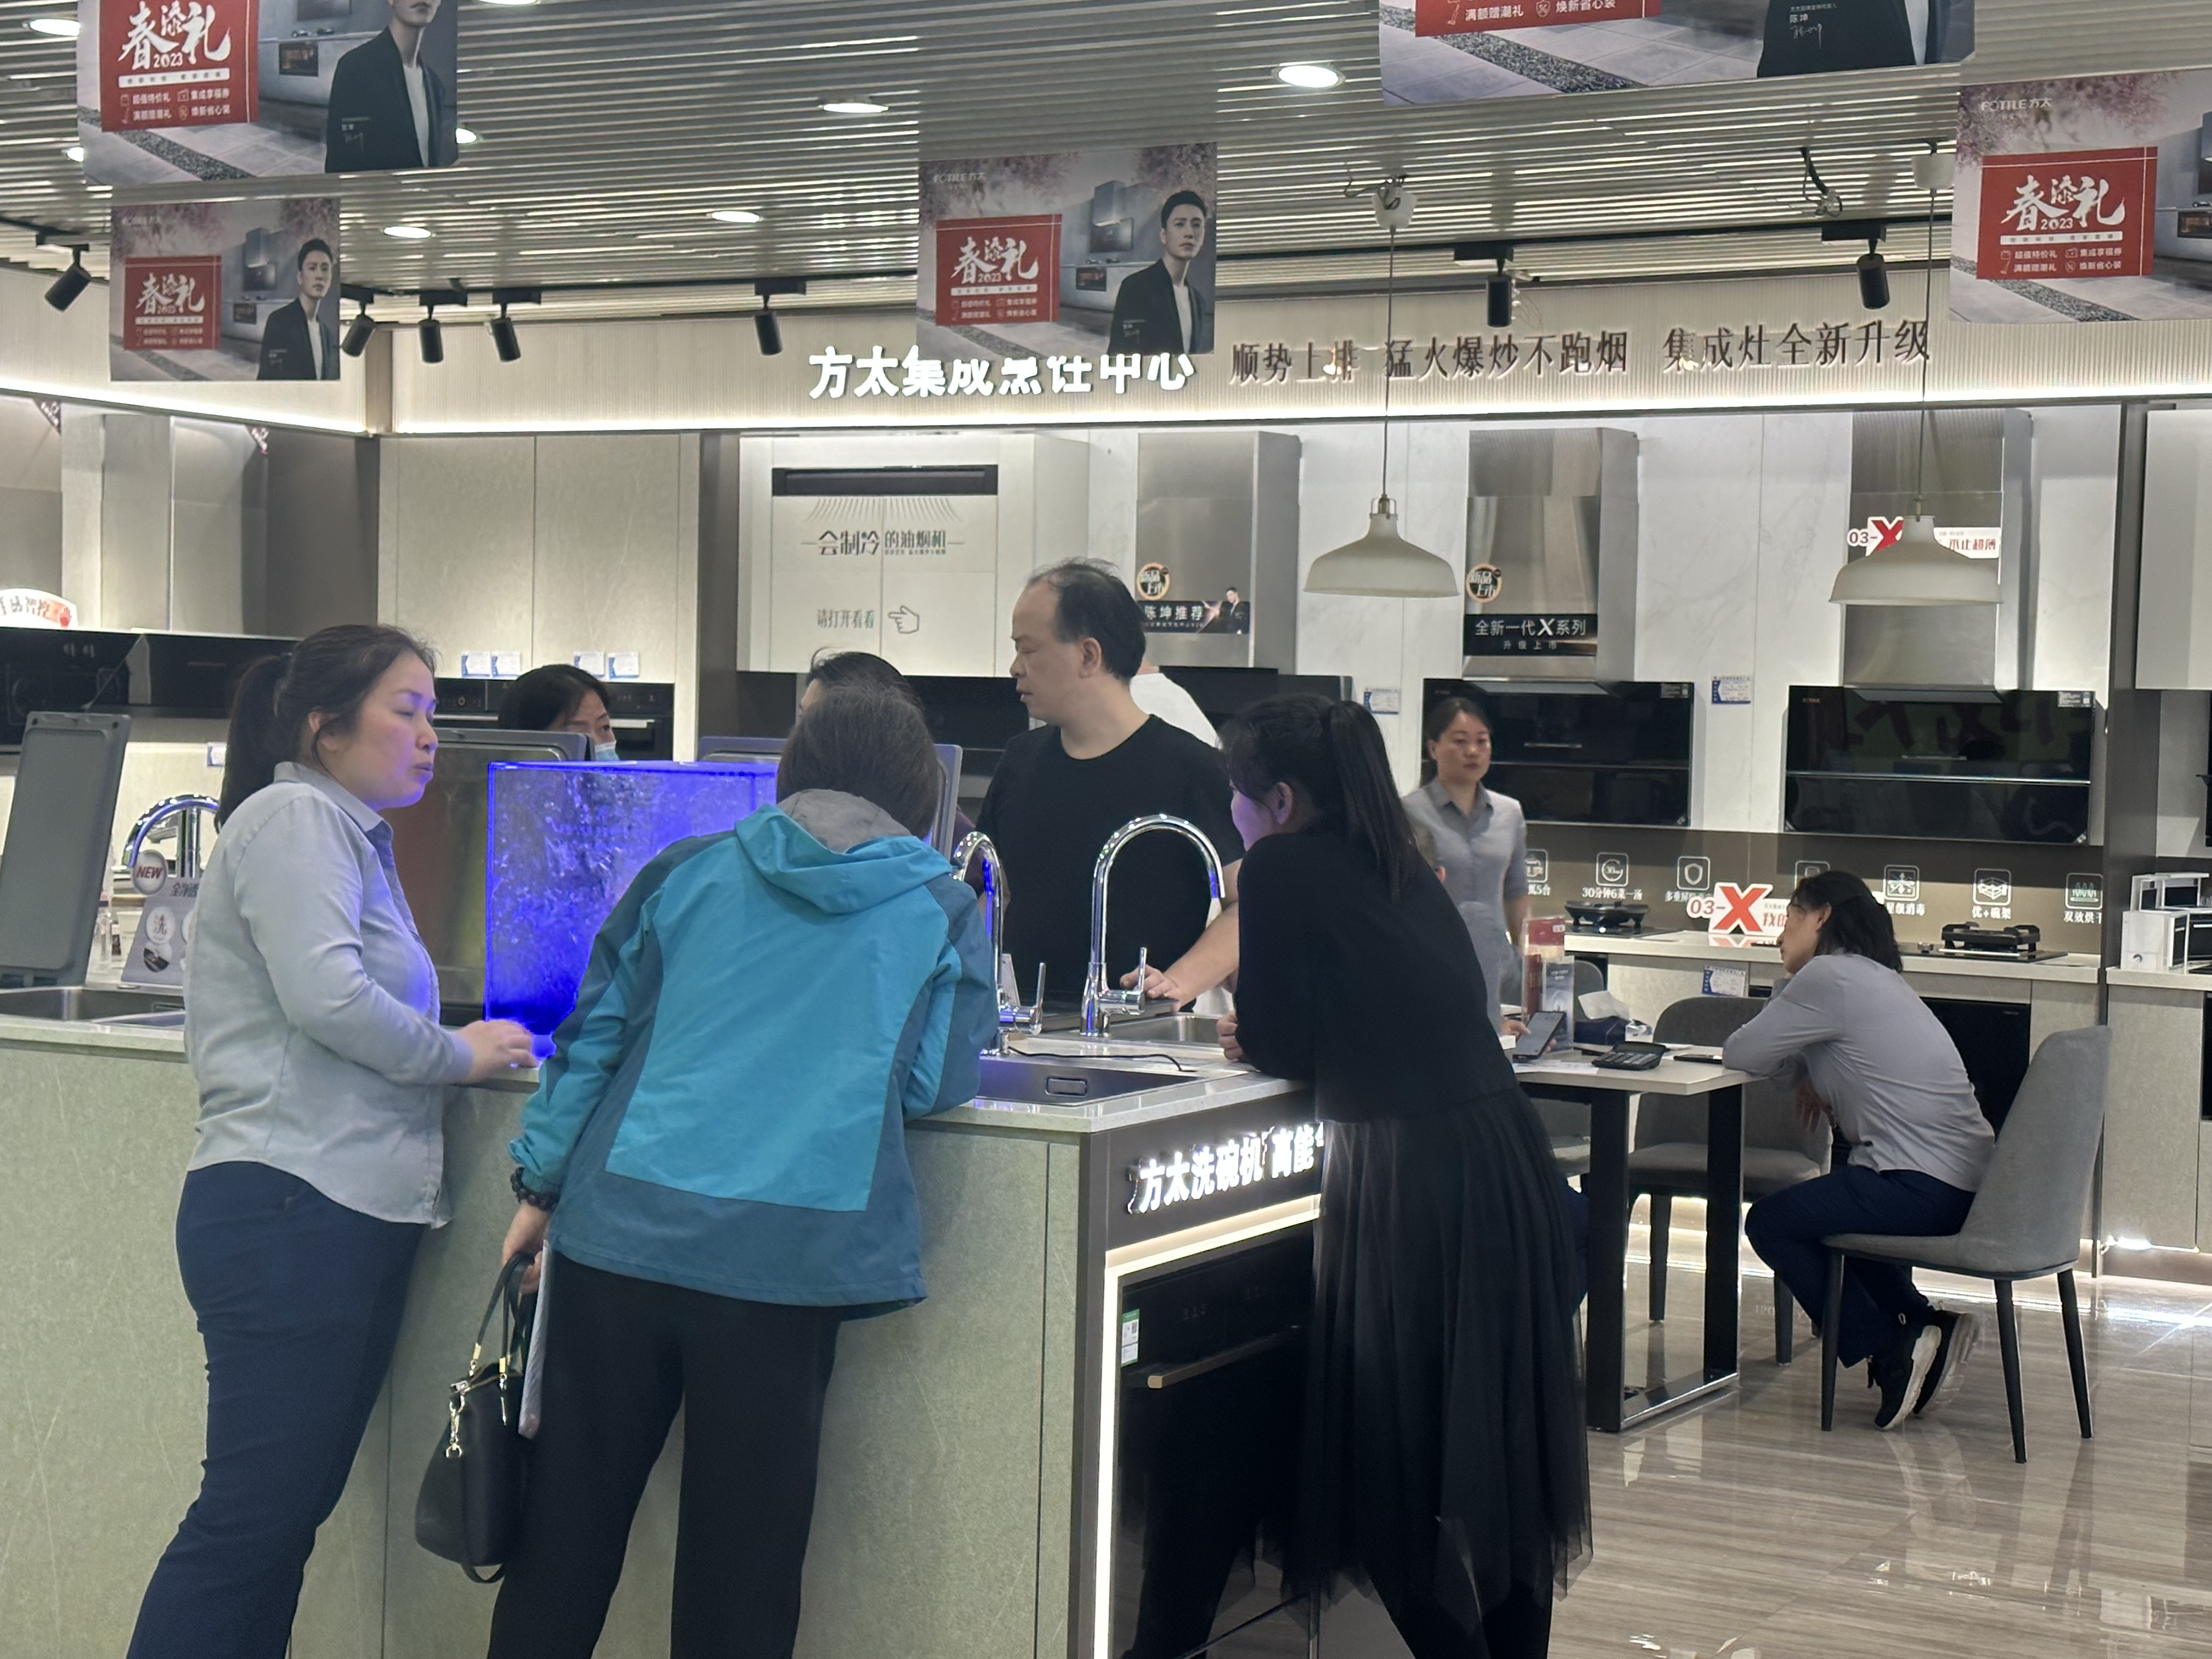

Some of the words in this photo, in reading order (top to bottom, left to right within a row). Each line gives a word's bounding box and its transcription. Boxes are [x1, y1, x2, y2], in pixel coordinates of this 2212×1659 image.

[154, 53, 183, 67] 2023
[1981, 98, 2027, 111] FOTILE
[2029, 98, 2052, 109] 方太
[2041, 218, 2073, 230] 2023
[978, 273, 1001, 283] 2023
[1383, 330, 1628, 381] 猛火爆炒不跑烟
[1663, 319, 1929, 374] 集成灶全新升级
[816, 609, 875, 629] 请打开看看
[1475, 618, 1586, 636] 全新一代X系列
[1503, 640, 1558, 651] 升级上市
[137, 866, 163, 878] NEW
[1690, 885, 1768, 932] 03-X
[1139, 1137, 1263, 1214] 方太洗碗机
[1271, 1122, 1324, 1179] 高能
